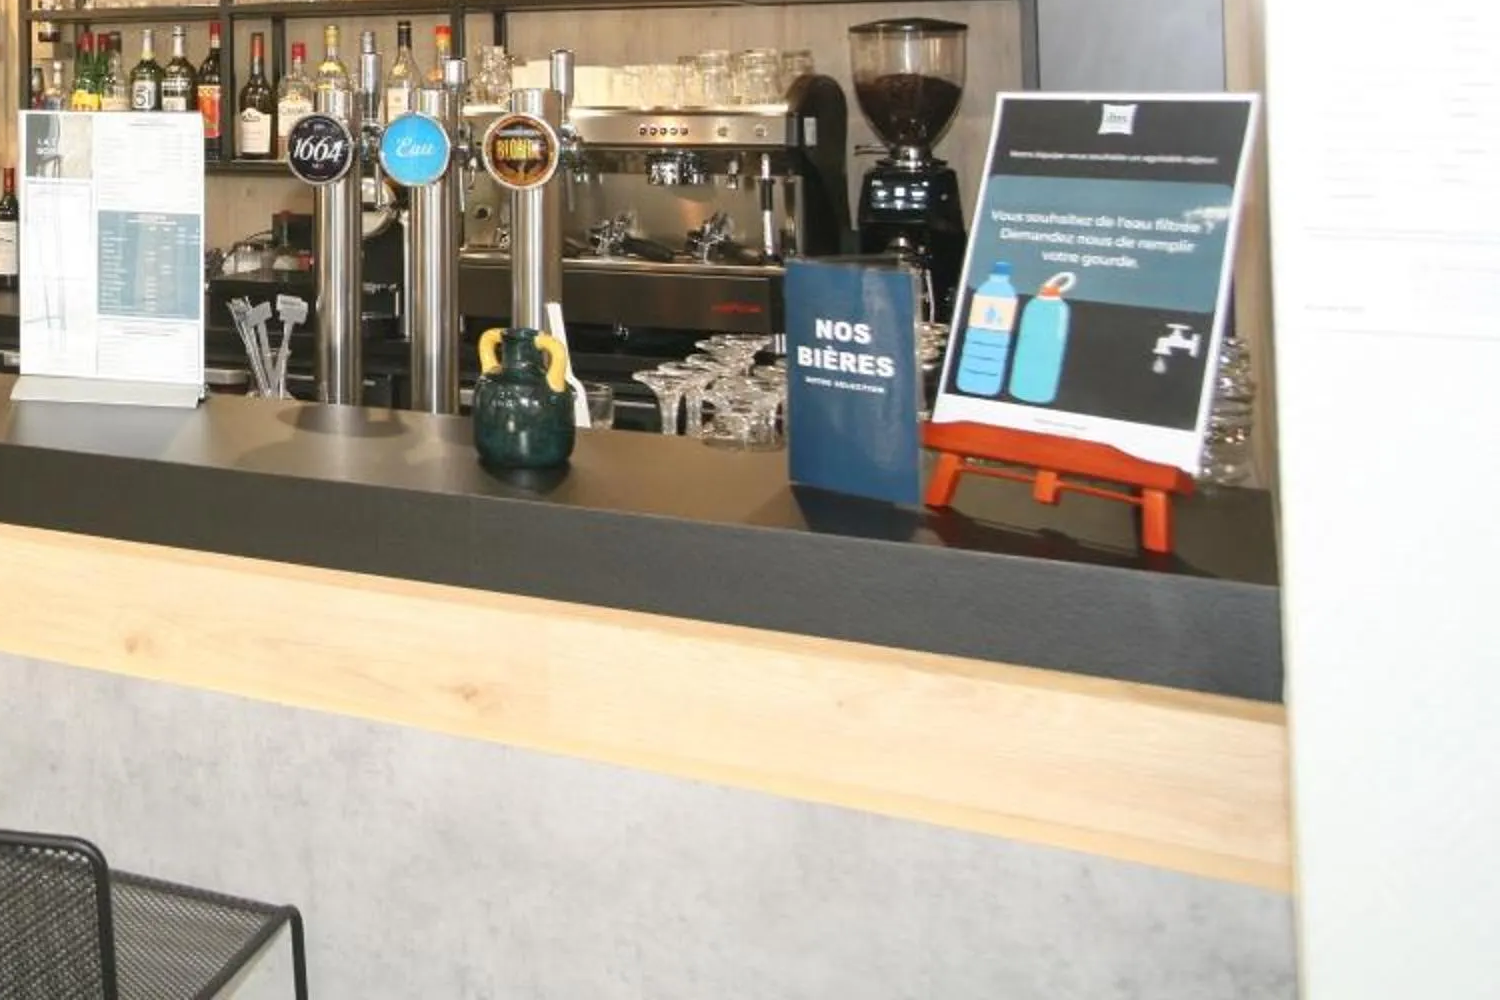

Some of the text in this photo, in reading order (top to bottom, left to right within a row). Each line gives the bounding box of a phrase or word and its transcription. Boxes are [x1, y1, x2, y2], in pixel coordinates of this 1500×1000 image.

[293, 135, 344, 163] 1664
[991, 209, 1024, 222] Vous
[1025, 211, 1093, 227] souhaitez
[1095, 215, 1115, 228] de
[1117, 216, 1151, 230] l'eau
[1000, 227, 1196, 254] Demandez nous de remplir
[1041, 250, 1079, 263] votre
[815, 318, 872, 345] NOS
[797, 345, 896, 377] BIÈRES
